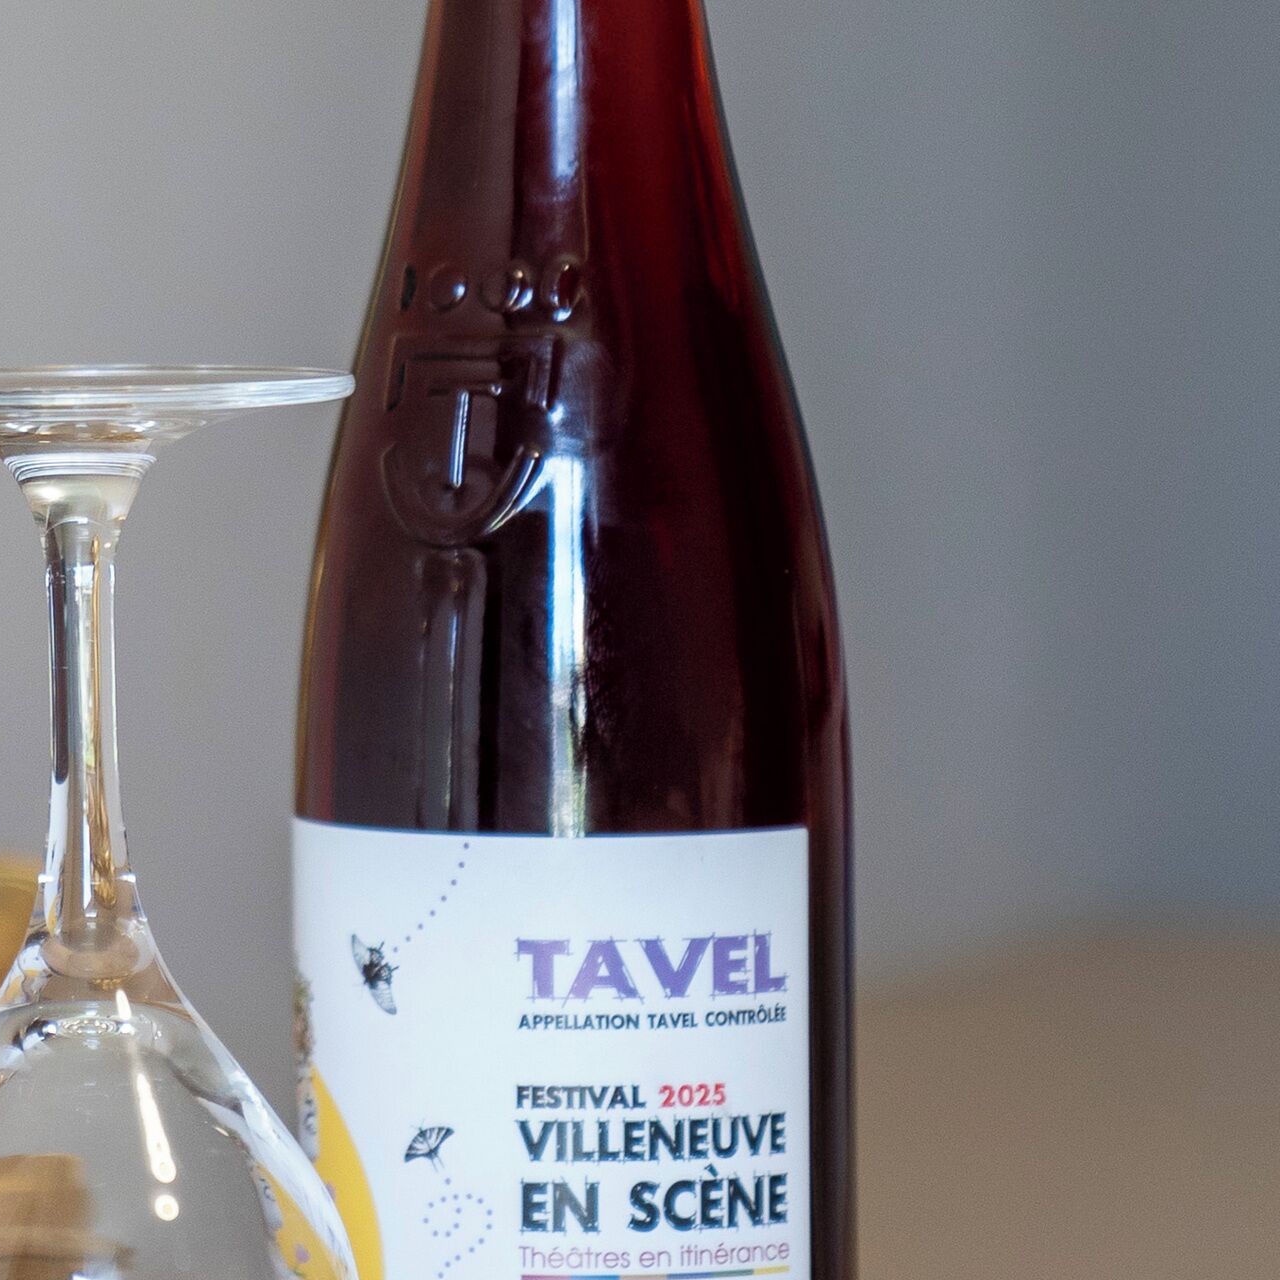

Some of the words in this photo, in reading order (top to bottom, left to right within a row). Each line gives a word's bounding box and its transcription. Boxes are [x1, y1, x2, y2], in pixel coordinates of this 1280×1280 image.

[516, 931, 788, 1004] TAVEL
[518, 1013, 640, 1030] APPELLATION
[648, 1011, 698, 1029] TAVEL
[705, 1002, 787, 1027] CONTRÔLÉE
[516, 1084, 646, 1109] FESTIVAL
[658, 1083, 726, 1108] 2025
[516, 1112, 787, 1163] VILLENEUVE
[520, 1178, 601, 1233] EN
[627, 1163, 788, 1233] SCÈNE
[519, 1245, 630, 1269] Théâtres
[639, 1248, 671, 1268] en
[680, 1241, 790, 1267] itinérance
